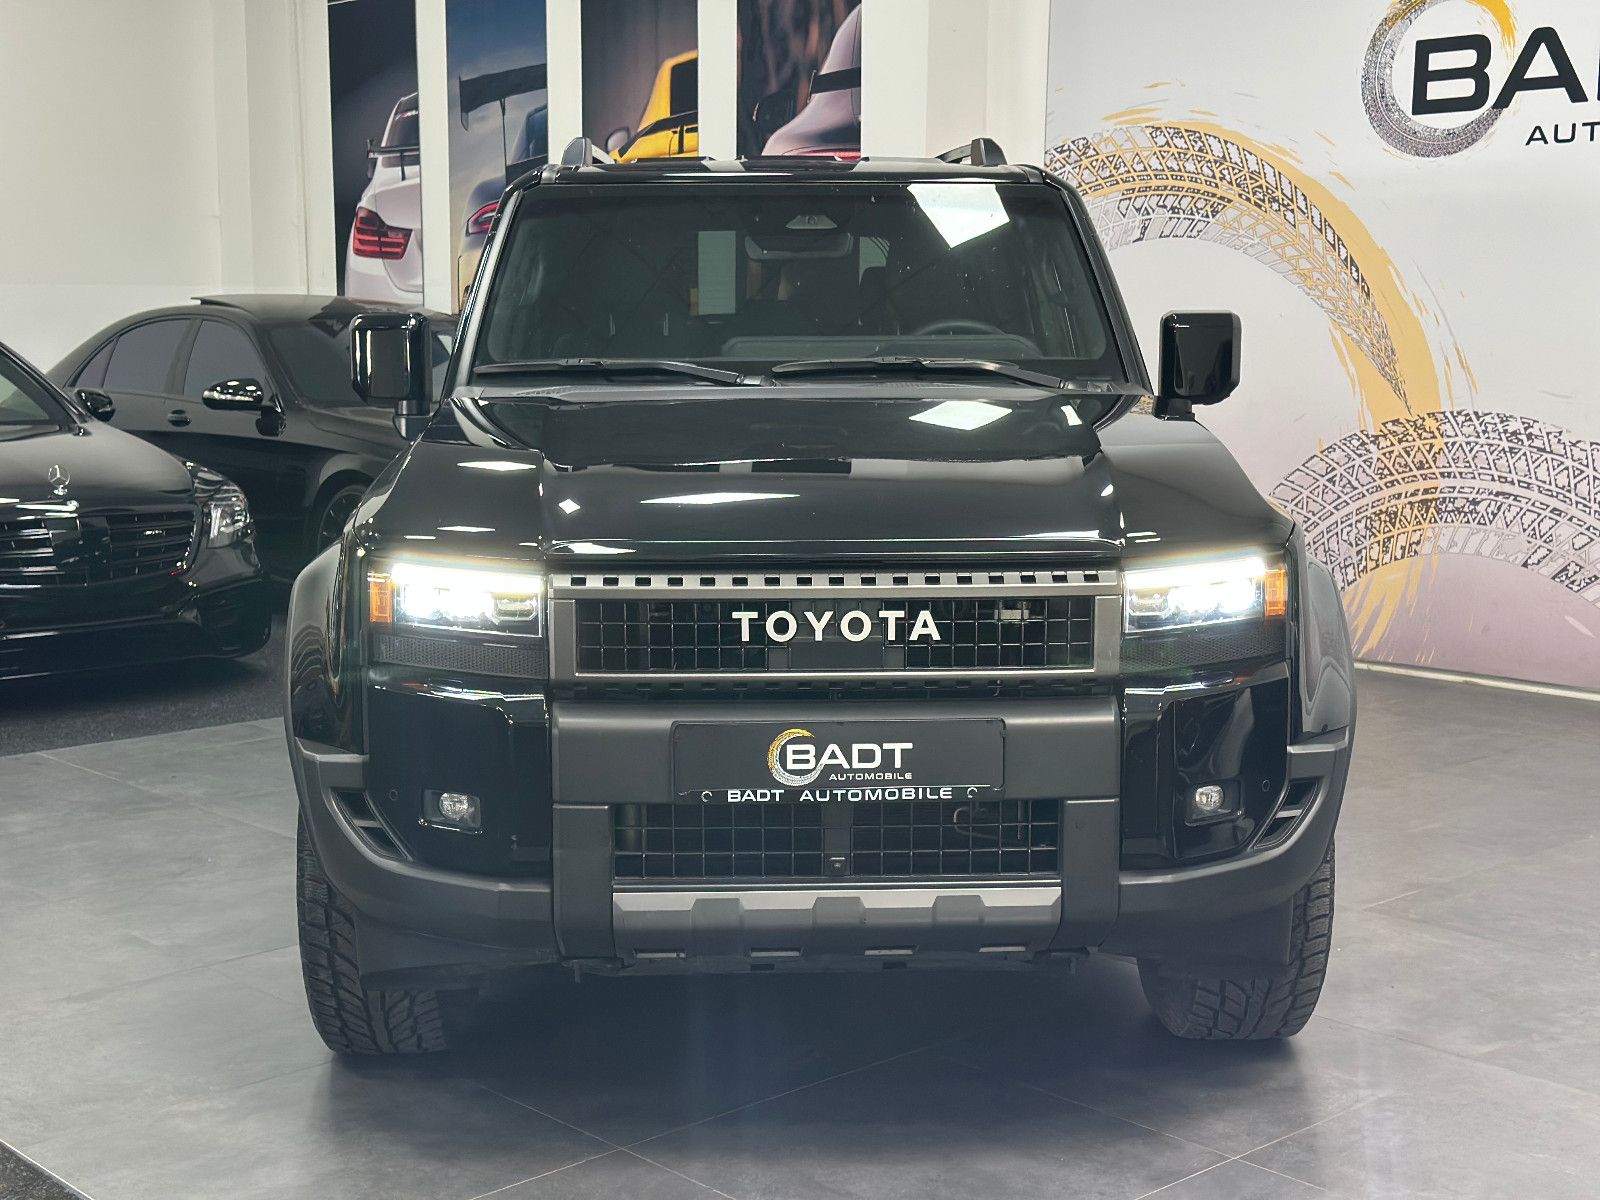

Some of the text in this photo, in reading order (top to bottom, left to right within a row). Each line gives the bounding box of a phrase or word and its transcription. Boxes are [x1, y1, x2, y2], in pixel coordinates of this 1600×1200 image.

[1411, 27, 1600, 115] BA
[1525, 122, 1600, 146] AUT
[732, 610, 941, 642] TOYOTA
[786, 743, 913, 770] BADT
[829, 772, 912, 781] AUTOMOBILE
[727, 787, 953, 802] BADT AUTOMOBILE
